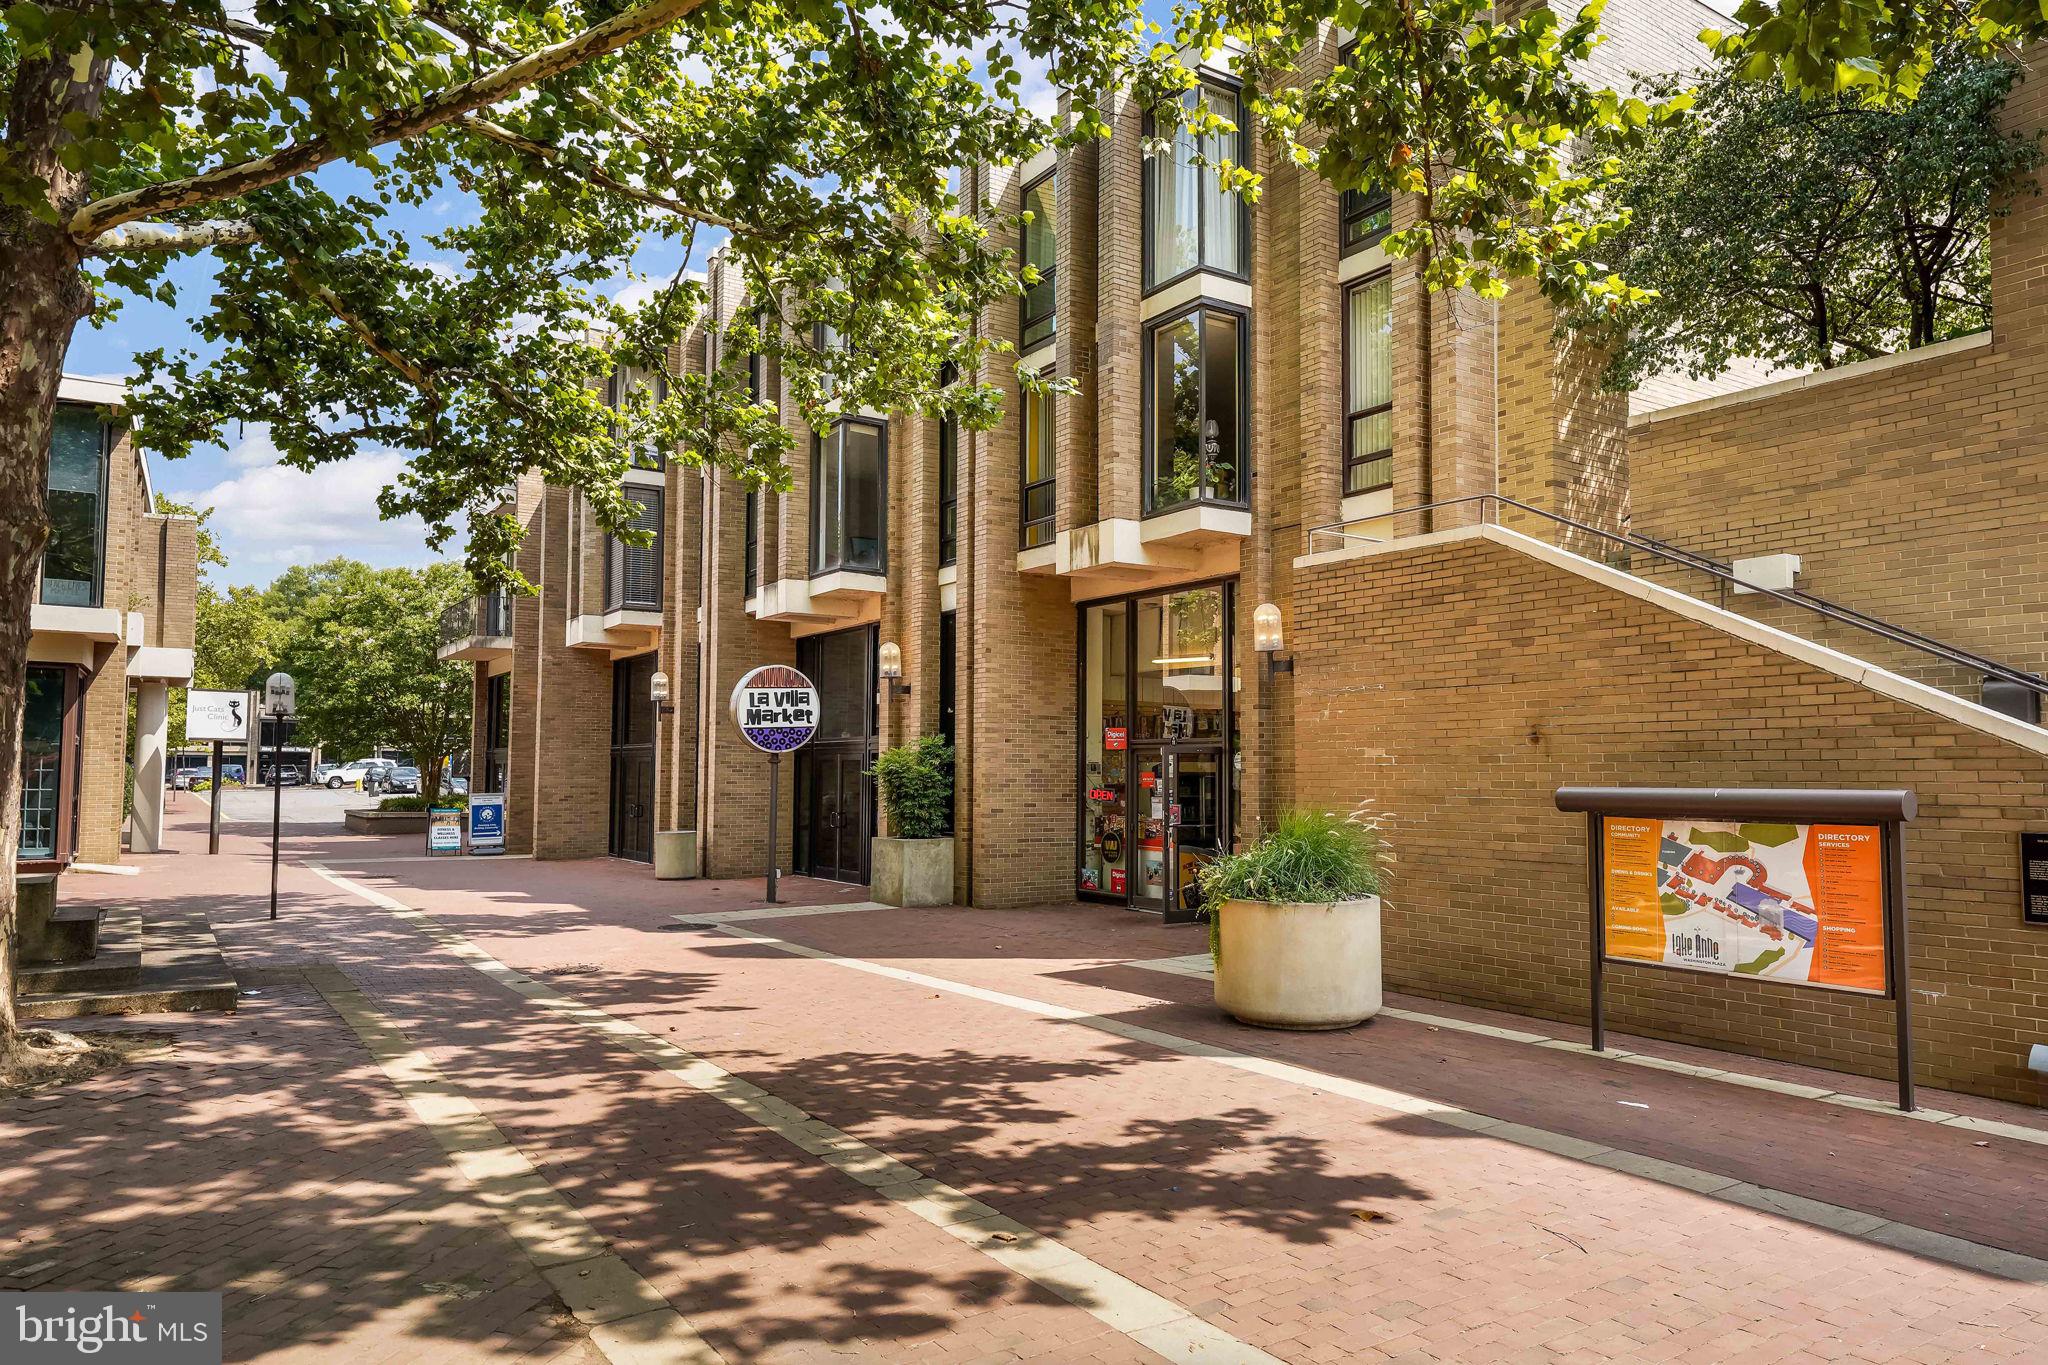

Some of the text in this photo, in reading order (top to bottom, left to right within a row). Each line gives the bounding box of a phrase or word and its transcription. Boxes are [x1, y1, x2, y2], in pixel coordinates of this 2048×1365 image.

[749, 690, 810, 707] La Villa
[744, 708, 813, 725] Market
[1089, 789, 1114, 800] OPEN
[1112, 870, 1126, 878] Digicel
[1672, 933, 1719, 960] Lake Anne
